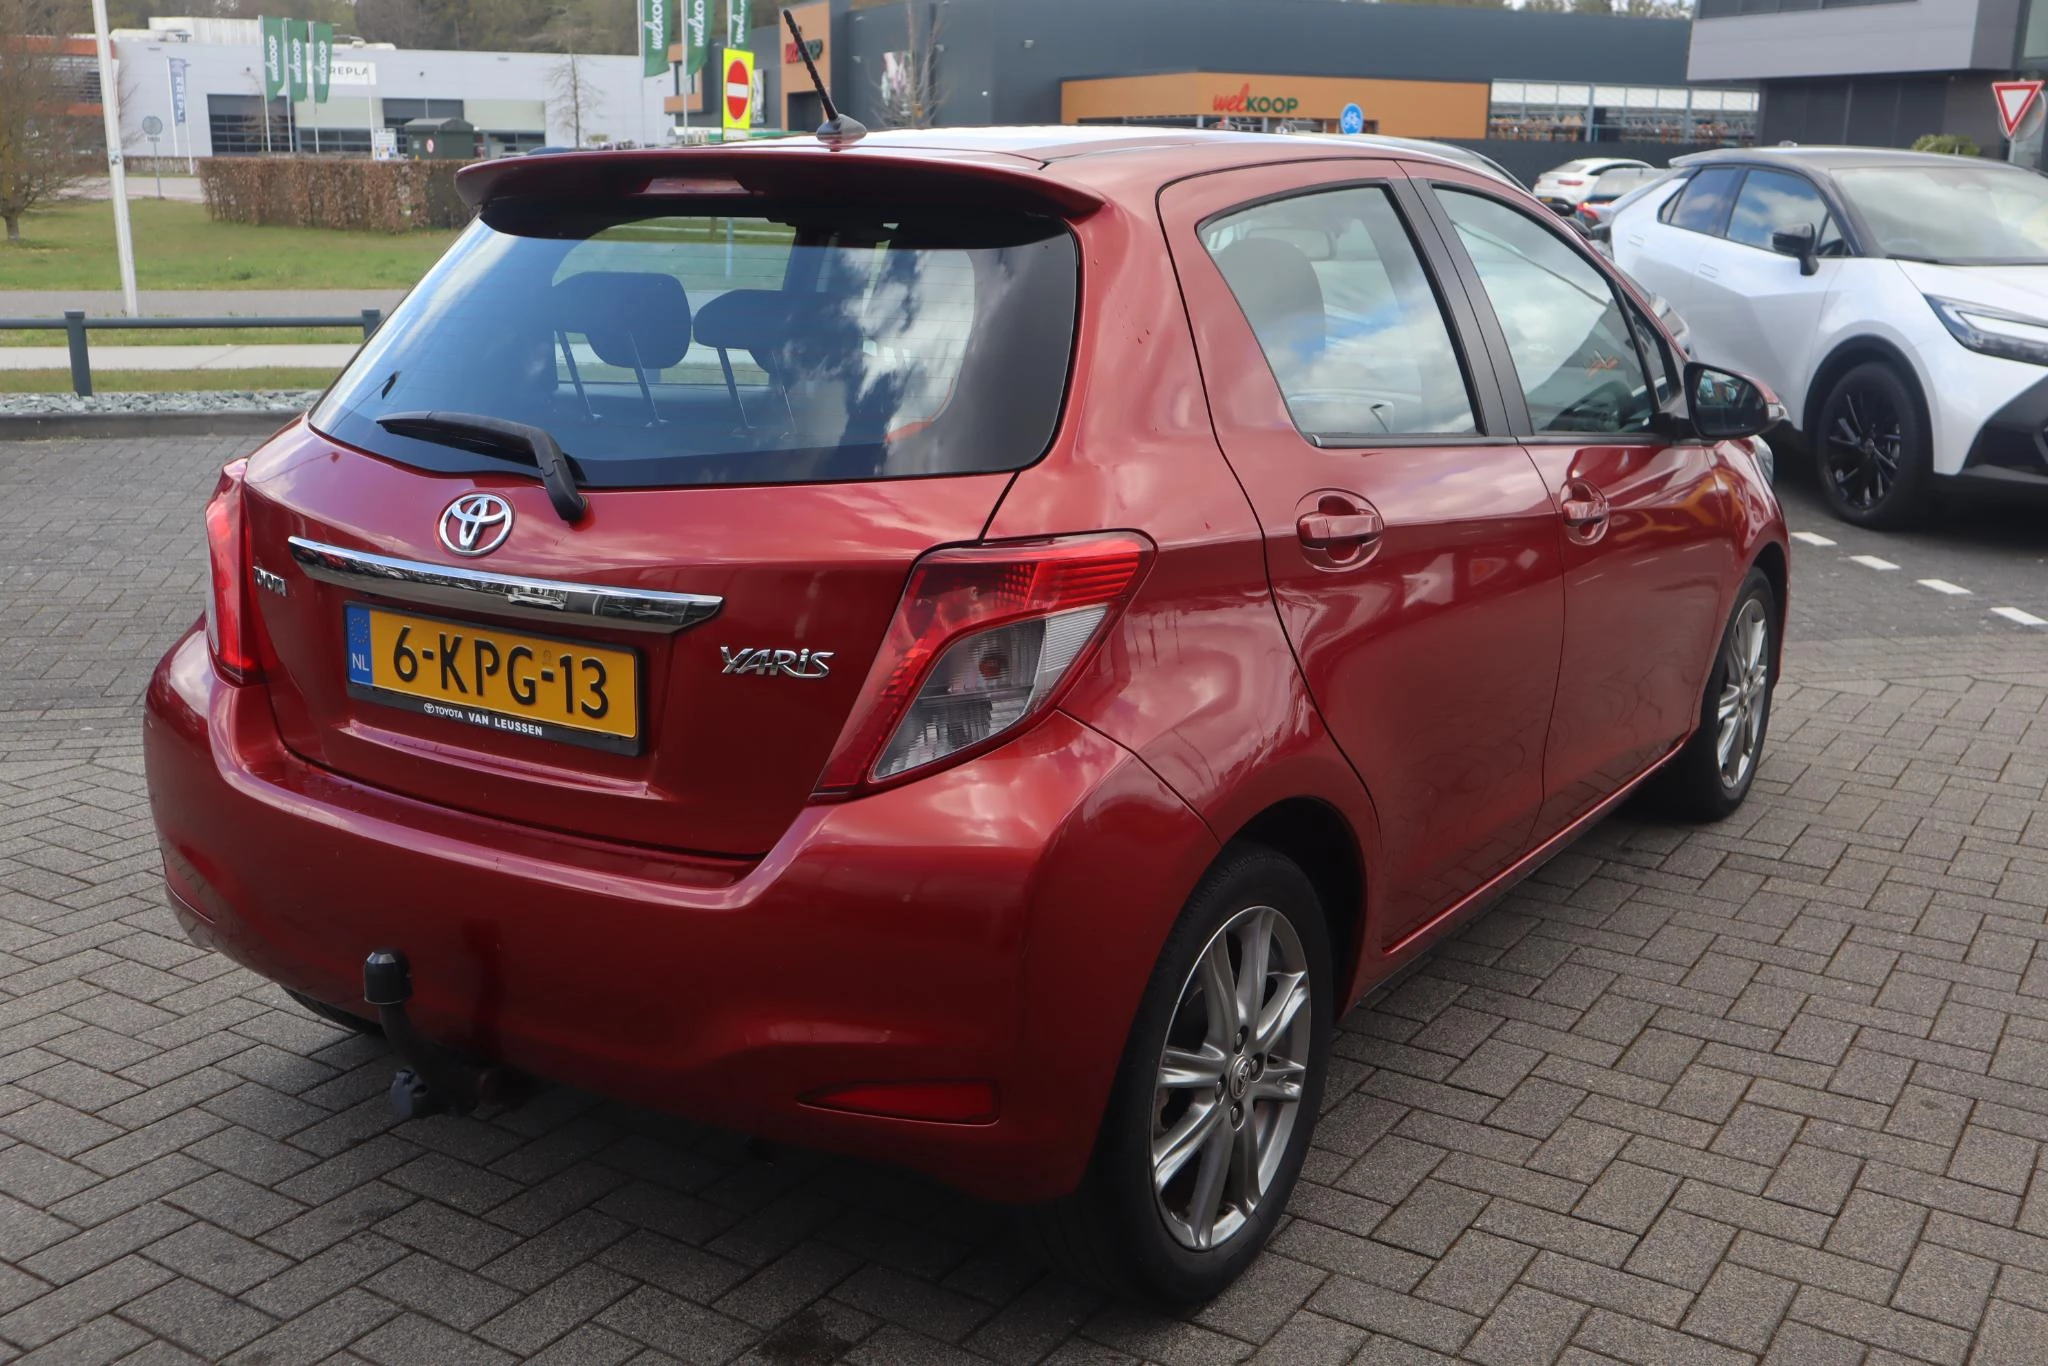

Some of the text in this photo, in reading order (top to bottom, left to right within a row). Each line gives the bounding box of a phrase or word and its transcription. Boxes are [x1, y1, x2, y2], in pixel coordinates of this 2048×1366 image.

[351, 624, 609, 719] NL 6-KPG-13
[434, 705, 543, 737] TOYOTA VAN LEUSSEN
